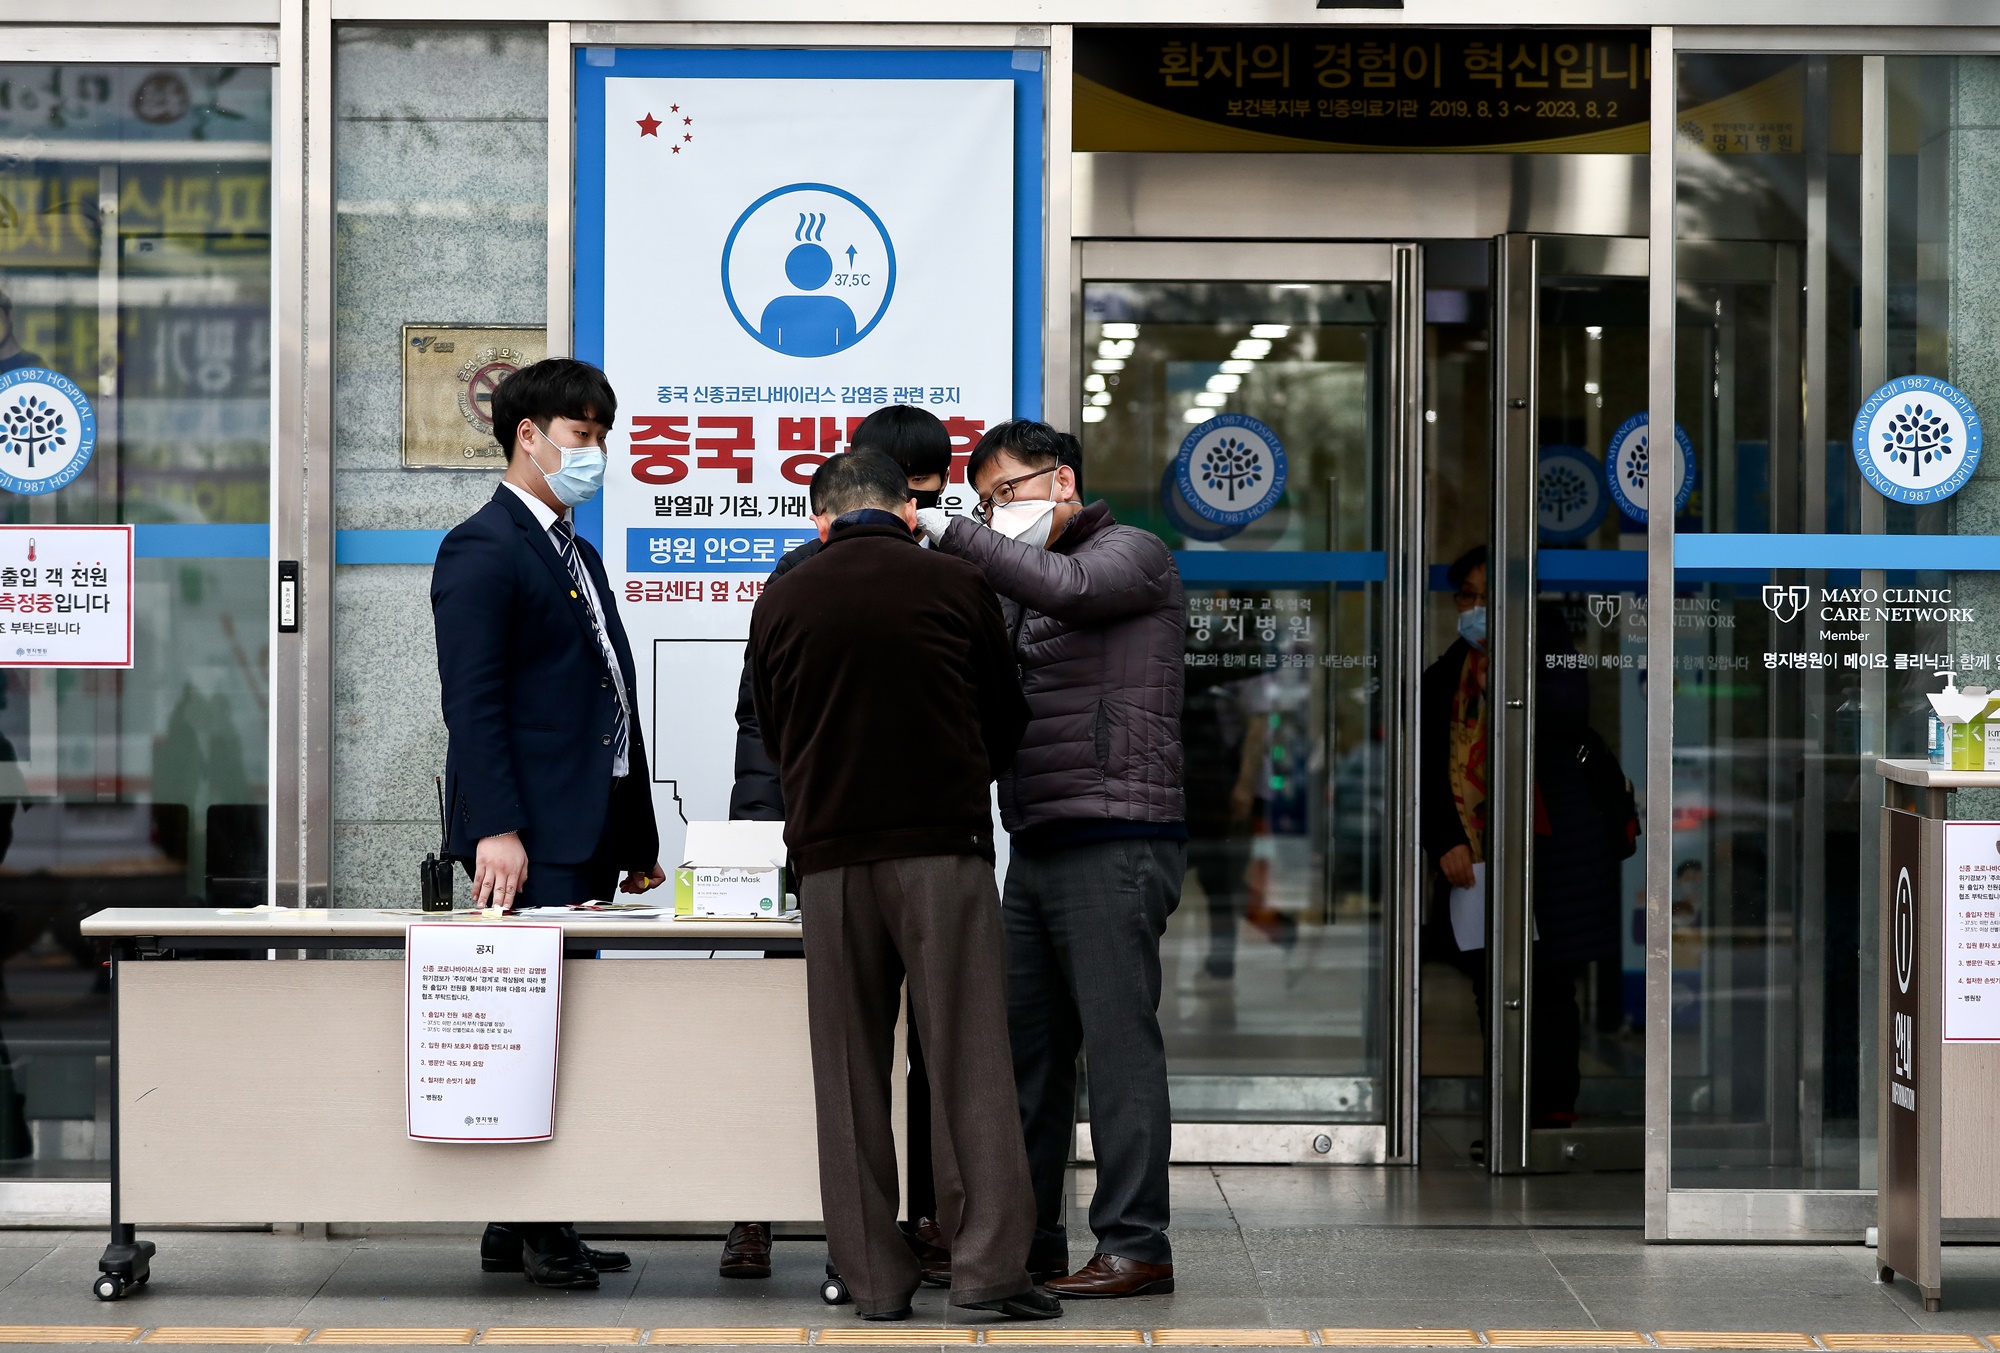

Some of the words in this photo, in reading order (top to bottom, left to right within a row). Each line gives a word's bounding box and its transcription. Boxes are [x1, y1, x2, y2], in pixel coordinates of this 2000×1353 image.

[1158, 41, 1290, 88] 환자의
[1313, 41, 1441, 88] 경험이
[1463, 42, 1650, 89] 혁신입니
[1226, 99, 1311, 118] 보건복지부
[1317, 99, 1418, 118] 인증의료기관
[1429, 101, 1472, 118] 2019.
[1536, 101, 1580, 119] 2023.
[1607, 101, 1618, 118] 2
[1712, 134, 1793, 152] 명지병원
[15, 370, 44, 381] 1987
[47, 372, 92, 421] HOSPITAL
[657, 386, 688, 403] 중국
[693, 386, 836, 403] 신종코로나바이러스
[841, 386, 888, 404] 감염증
[893, 386, 924, 404] 관련
[929, 386, 960, 404] 공지
[1857, 383, 1898, 432] MYONGJI
[1900, 378, 1930, 390] 1987
[1932, 381, 1978, 430] HOSPITAL
[629, 415, 755, 485] 중국
[778, 416, 868, 485] 방
[1180, 421, 1215, 463] MYONGJI
[1217, 415, 1242, 426] 1987
[1243, 417, 1284, 459] HOSPITAL
[1607, 419, 1638, 460] MYONGJI
[1674, 426, 1693, 458] SPITAL
[18, 481, 46, 492] 1987
[49, 438, 93, 488] HOSPITAL
[1857, 448, 1899, 497] MYONGJI
[1902, 490, 1931, 501] 1987
[1934, 447, 1979, 497] HOSPITAL
[654, 495, 714, 517] 발열과
[719, 495, 763, 518] 기침,
[767, 495, 806, 517] 가래
[1180, 476, 1216, 518] MYONGJI
[1220, 512, 1245, 523] 1987
[1247, 475, 1285, 519] HOSPITAL
[1608, 474, 1638, 518] MYONGJI
[1674, 474, 1694, 511] SPITAL
[649, 537, 696, 564] 병원
[703, 537, 776, 564] 안으로
[0, 567, 37, 588] 출입
[45, 567, 63, 587] 객
[71, 567, 107, 588] 전원
[624, 580, 703, 602] 응급센터
[710, 581, 729, 602] 옆
[1820, 588, 1878, 603] MAYO
[1882, 588, 1952, 603] CLINIC
[0, 592, 110, 613] 측정중입니다
[1189, 598, 1253, 612] 한양대학교
[1260, 598, 1312, 612] 교육협력
[1820, 607, 1871, 622] CARE
[1875, 607, 1974, 622] NETWORK
[10, 622, 81, 635] 부탁드립니다
[1189, 614, 1312, 642] 명지병원
[1819, 630, 1870, 641] Member
[1222, 653, 1246, 668] 함께
[1250, 653, 1261, 668] 더
[1264, 654, 1277, 667] 큰
[1281, 654, 1315, 668] 걸음을
[1545, 653, 1598, 669] 명지병원이
[1602, 653, 1634, 669] 메이요
[1684, 656, 1704, 670] 함께
[1707, 656, 1749, 670] 일합니다
[1763, 652, 1838, 669] 명지병원이
[1844, 652, 1889, 669] 메이요
[1893, 653, 1955, 670] 클리닉과
[1960, 653, 1990, 670] 함께
[475, 944, 494, 955] 공지
[1895, 1011, 1912, 1080] 안내
